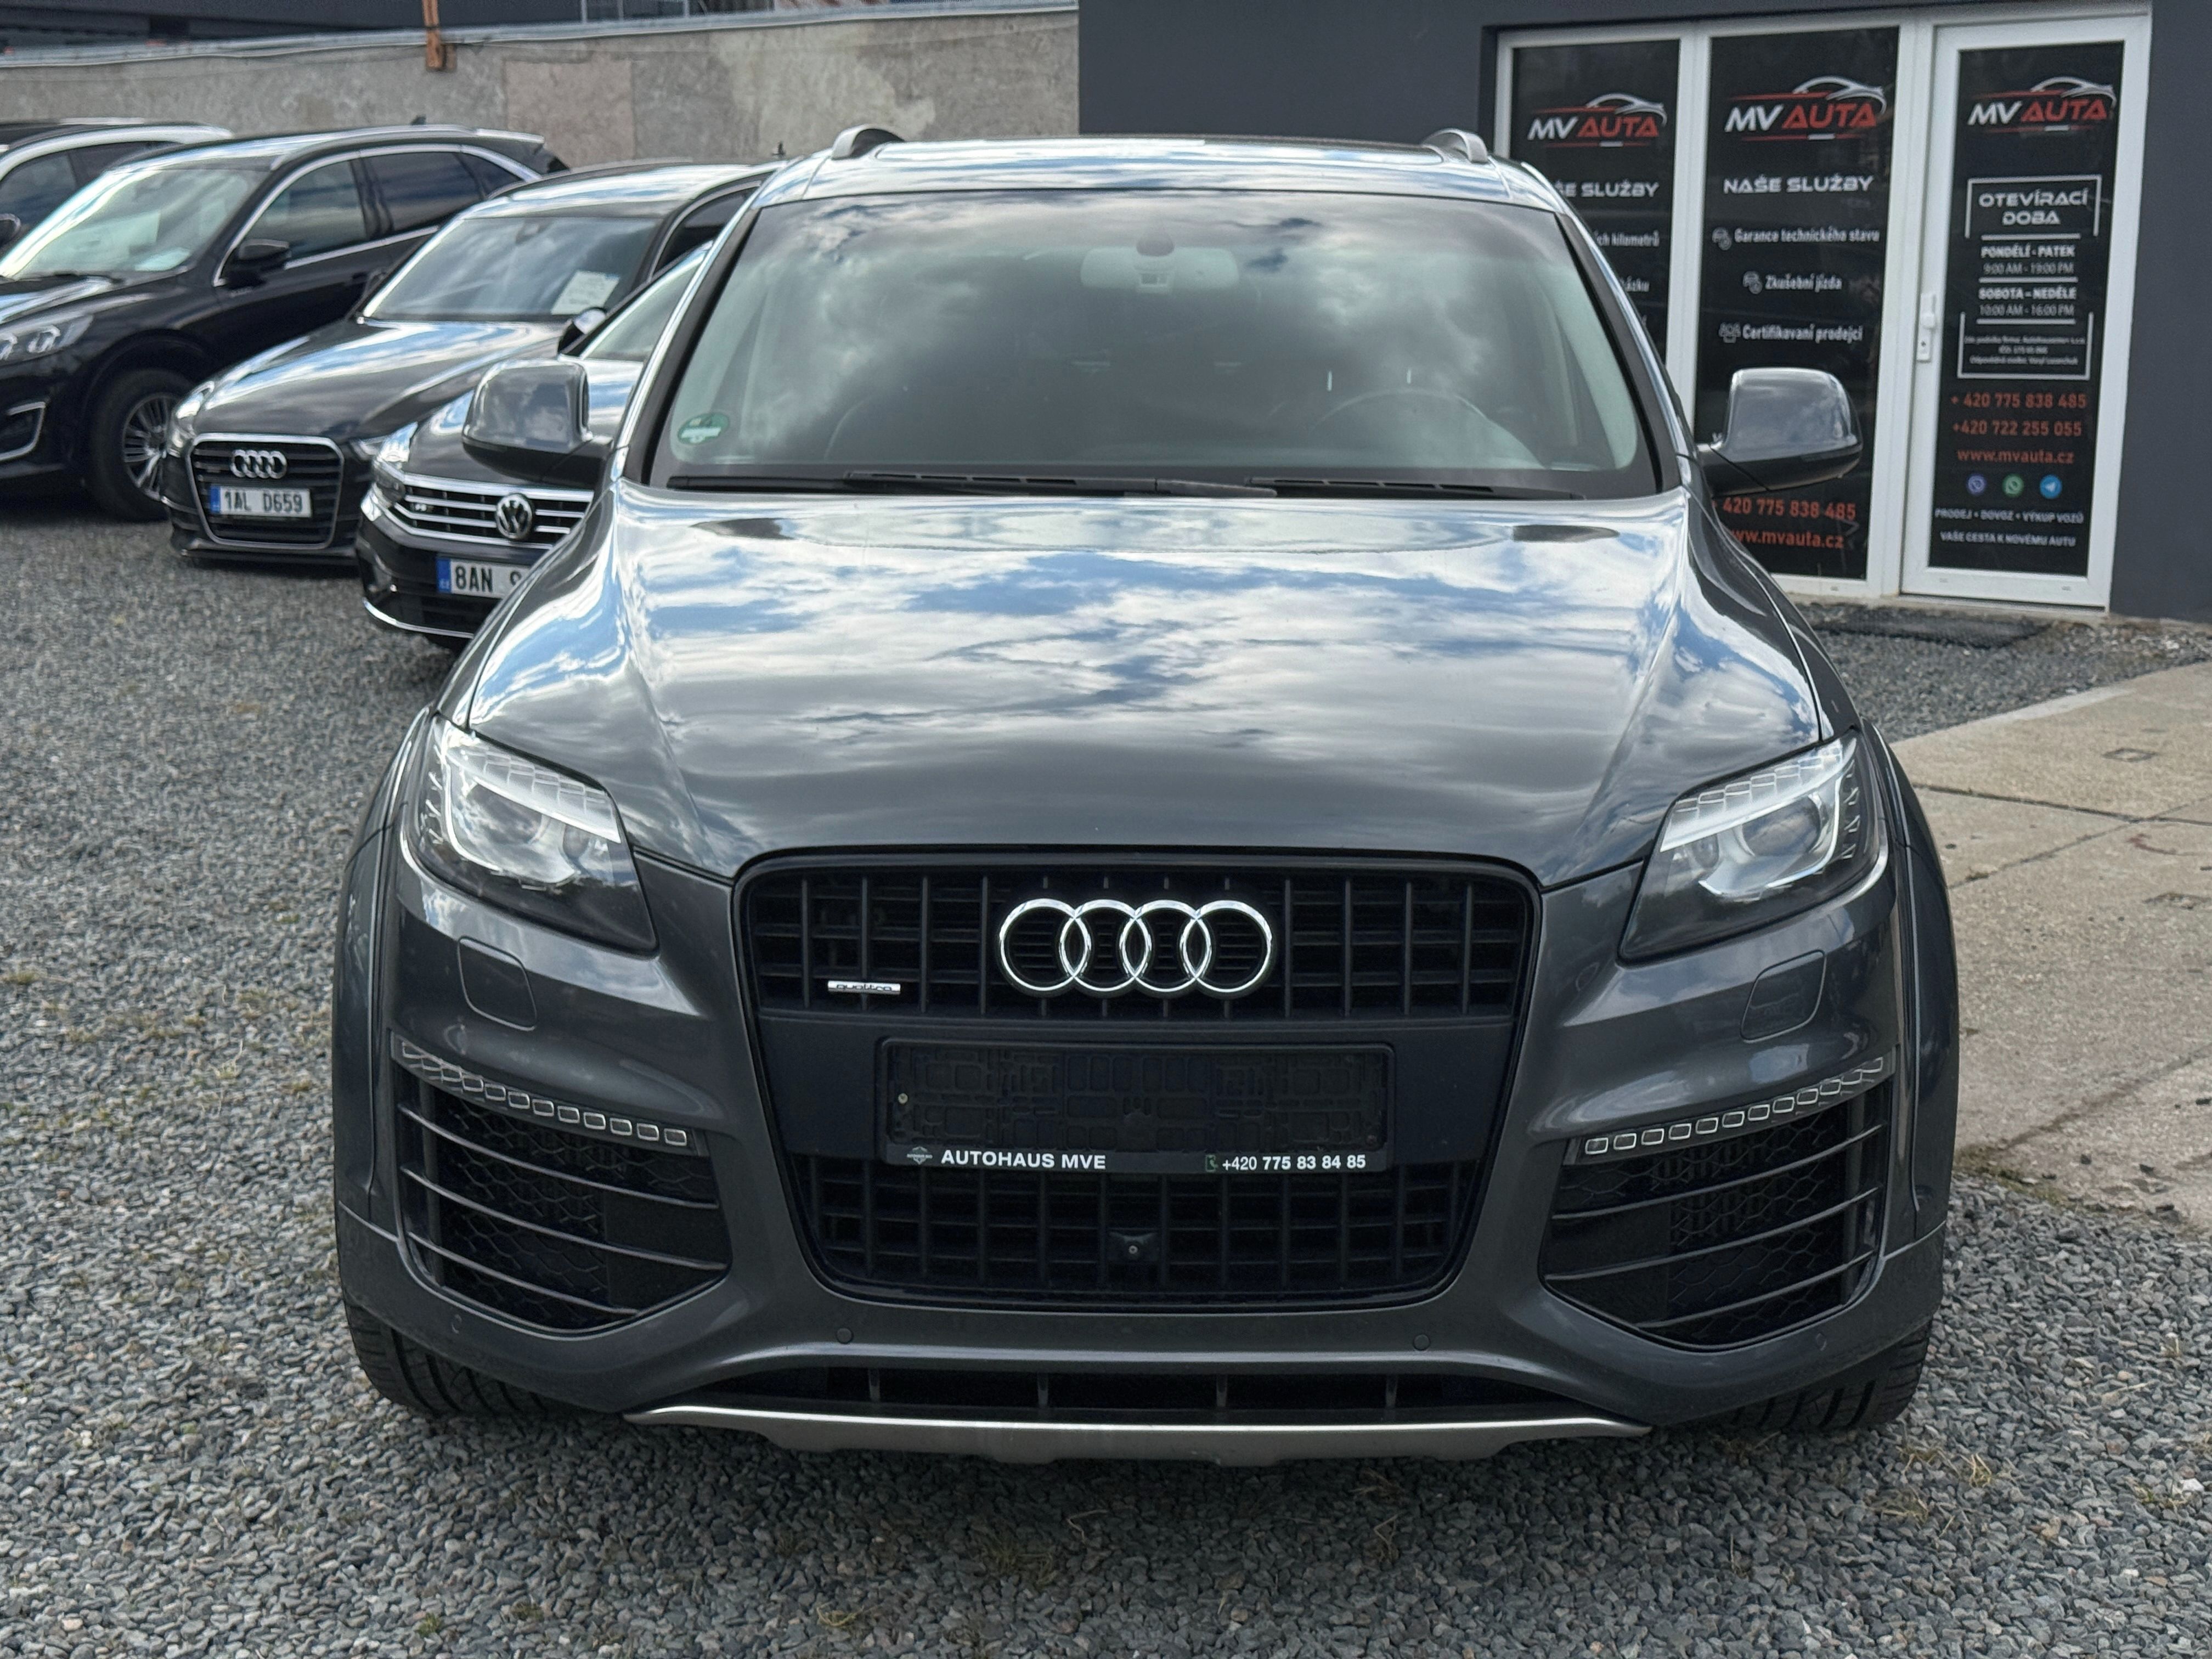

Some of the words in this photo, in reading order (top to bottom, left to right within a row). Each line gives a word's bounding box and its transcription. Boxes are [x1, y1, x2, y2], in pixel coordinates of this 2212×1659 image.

[1724, 104, 1784, 132] MV
[1782, 103, 1876, 128] AUTA
[1968, 101, 2022, 125] MV
[2021, 99, 2107, 122] AUTA
[1527, 116, 1578, 140] MV
[1577, 116, 1659, 137] AUTA
[1581, 178, 1660, 198] SLUŽBY
[1724, 173, 1782, 194] NAŠE
[1787, 173, 1874, 192] SLUŽBY
[1978, 188, 2089, 207] OTEVÍRACÍ
[2002, 211, 2061, 225] DOBA
[1735, 228, 1779, 242] Garance
[1781, 225, 1847, 242] technického
[1848, 228, 1880, 242] stavu
[2005, 263, 2022, 274] AM
[2058, 262, 2074, 273] PM
[1765, 273, 1814, 290] Zkušební
[1815, 273, 1842, 292] jízda
[1978, 287, 2024, 300] SOBOTA
[2006, 304, 2023, 315] AM
[2058, 304, 2074, 315] PM
[1963, 392, 1990, 408] 420
[1995, 392, 2020, 408] 775
[2025, 393, 2053, 408] 838
[2058, 393, 2087, 409] 485
[1992, 421, 2017, 436] 722
[2022, 421, 2049, 436] 255
[2054, 421, 2081, 436] 055
[1957, 449, 2074, 464] www.mvauta.cz
[224, 491, 251, 511] 1AL
[263, 493, 303, 514] D659
[1723, 498, 1752, 515] 420
[1757, 498, 1784, 516] 775
[1790, 500, 1819, 518] 838
[1824, 502, 1856, 520] 485
[1730, 530, 1844, 549] ww.mvauta.cz
[455, 565, 493, 592] 8AN
[941, 1150, 1054, 1168] AUTOHAUS
[1061, 1154, 1106, 1170] MVE
[1222, 1156, 1257, 1171] +420
[1262, 1156, 1291, 1170] 775
[1297, 1155, 1316, 1170] 83
[1322, 1155, 1341, 1169] 84
[1347, 1154, 1366, 1169] 85
